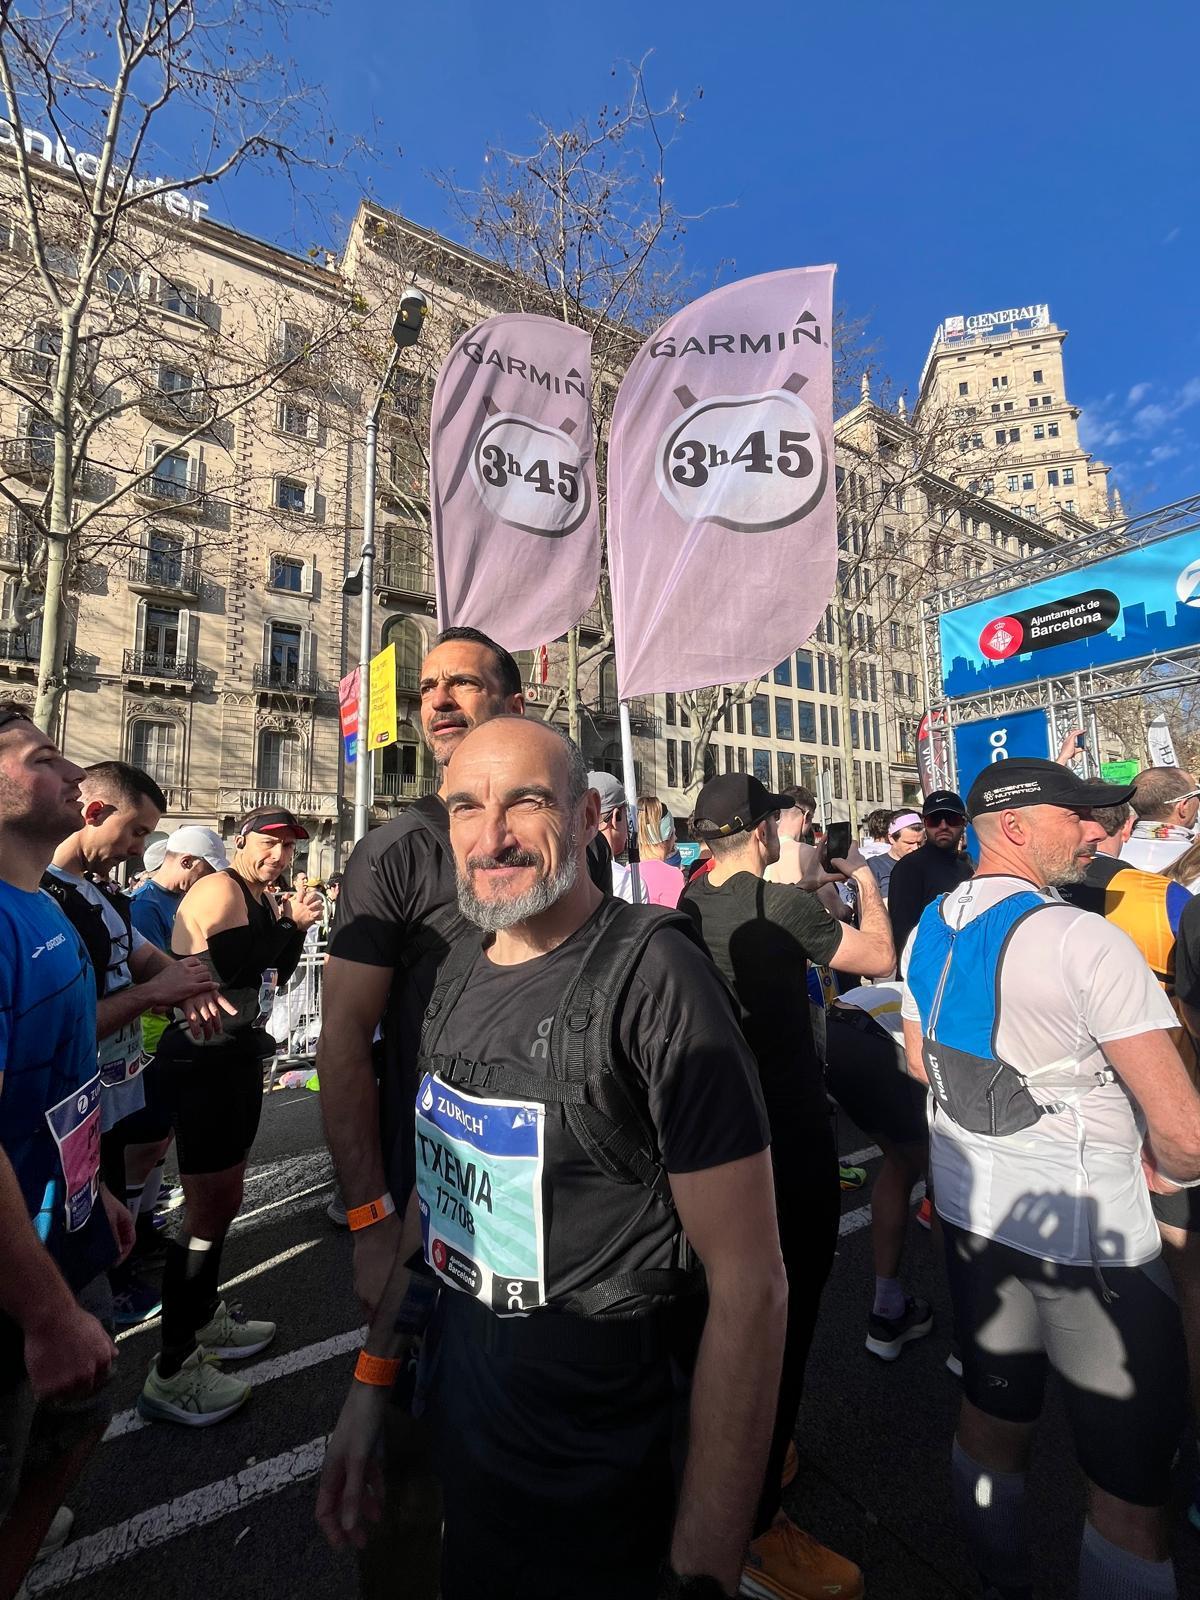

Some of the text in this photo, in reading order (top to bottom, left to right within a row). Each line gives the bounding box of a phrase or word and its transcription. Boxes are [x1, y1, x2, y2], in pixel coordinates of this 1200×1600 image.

[650, 322, 822, 358] GARMIN
[462, 343, 586, 399] GARMIN
[482, 444, 579, 504] 3h45
[672, 430, 814, 488] 3h45
[1031, 600, 1100, 626] Ajuntament de
[1031, 612, 1102, 639] Barcelona
[994, 786, 1041, 799] NUTRITION
[437, 1096, 485, 1136] ZURICH
[417, 1131, 493, 1214] TXEMA
[436, 1186, 476, 1235] 17708
[448, 1262, 476, 1288] Barcelona
